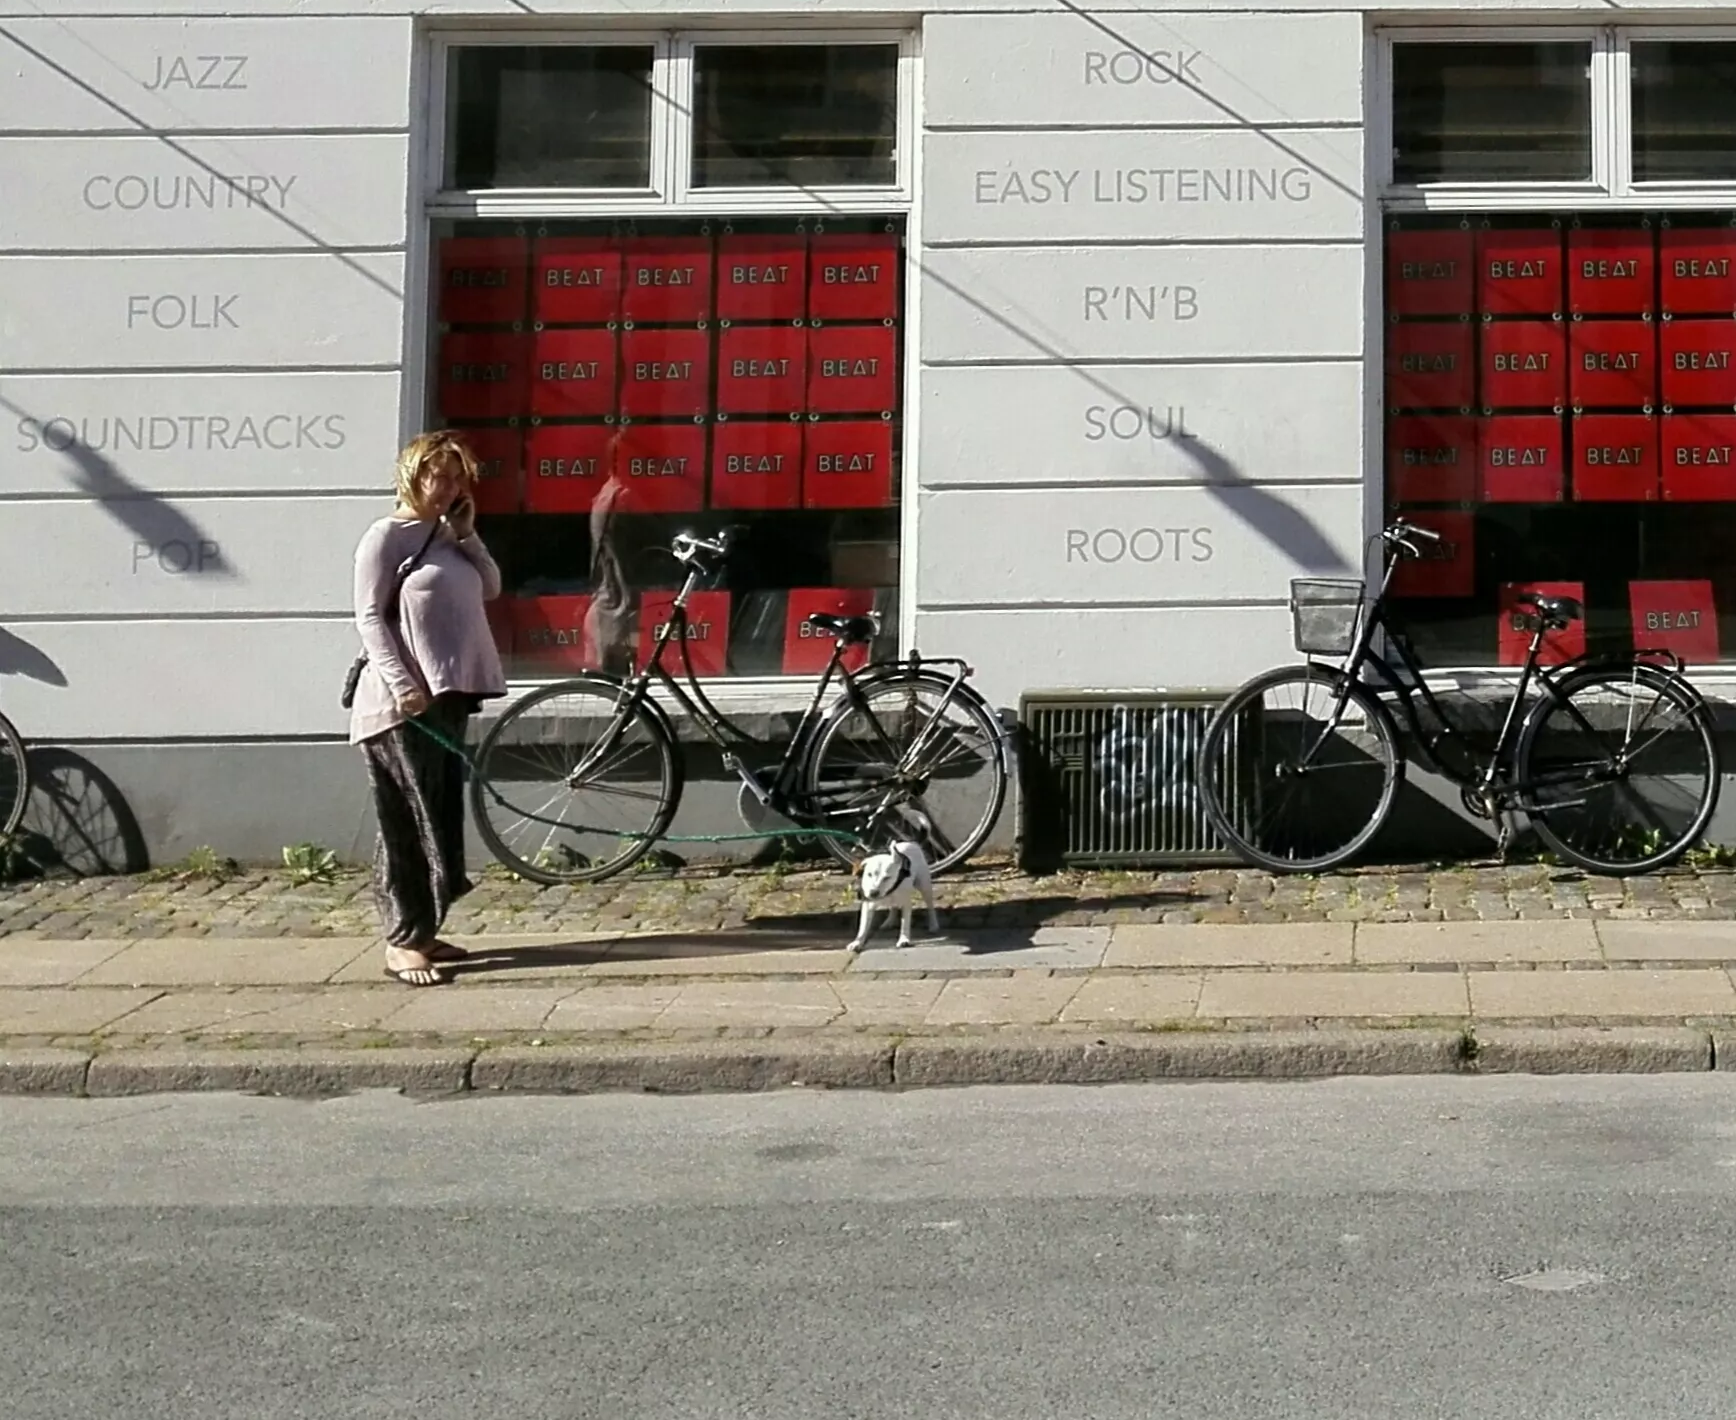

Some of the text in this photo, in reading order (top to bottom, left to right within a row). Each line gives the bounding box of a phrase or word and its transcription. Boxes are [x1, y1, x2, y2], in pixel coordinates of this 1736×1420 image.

[143, 56, 248, 91] JAZZ
[1085, 50, 1201, 84] ROCK
[84, 175, 297, 211] COUNTRY
[975, 168, 1311, 203] EASY LISTENING
[638, 268, 694, 285] BEAT
[733, 266, 788, 283] BEAT
[824, 266, 879, 283] BEAT
[1402, 262, 1456, 277] BEAT
[1492, 261, 1545, 277] BEAT
[1584, 260, 1637, 277] BEAT
[1675, 260, 1729, 276] BEAT
[452, 269, 507, 286] BEAT
[547, 269, 603, 286] BEAT
[127, 294, 239, 329] FOLK
[733, 360, 789, 377] BEAT
[823, 359, 878, 377] BEAT
[1402, 355, 1457, 370] BEAT
[1495, 353, 1549, 371] BEAT
[1585, 353, 1639, 370] BEAT
[1675, 352, 1729, 369] BEAT
[452, 364, 507, 380] BEAT
[543, 363, 598, 379] BEAT
[636, 363, 691, 379] BEAT
[1085, 406, 1198, 440] SOUL
[18, 415, 346, 452] SOUNDTRACKS
[727, 456, 784, 473] BEAT
[818, 455, 875, 472] BEAT
[1404, 449, 1457, 464] BEAT
[1492, 449, 1546, 466] BEAT
[1588, 448, 1641, 464] BEAT
[1677, 448, 1731, 464] BEAT
[540, 459, 597, 476] BEAT
[631, 459, 687, 476] BEAT
[1067, 527, 1213, 562] ROOTS
[133, 539, 220, 574] POP
[1647, 611, 1698, 629] BEAT
